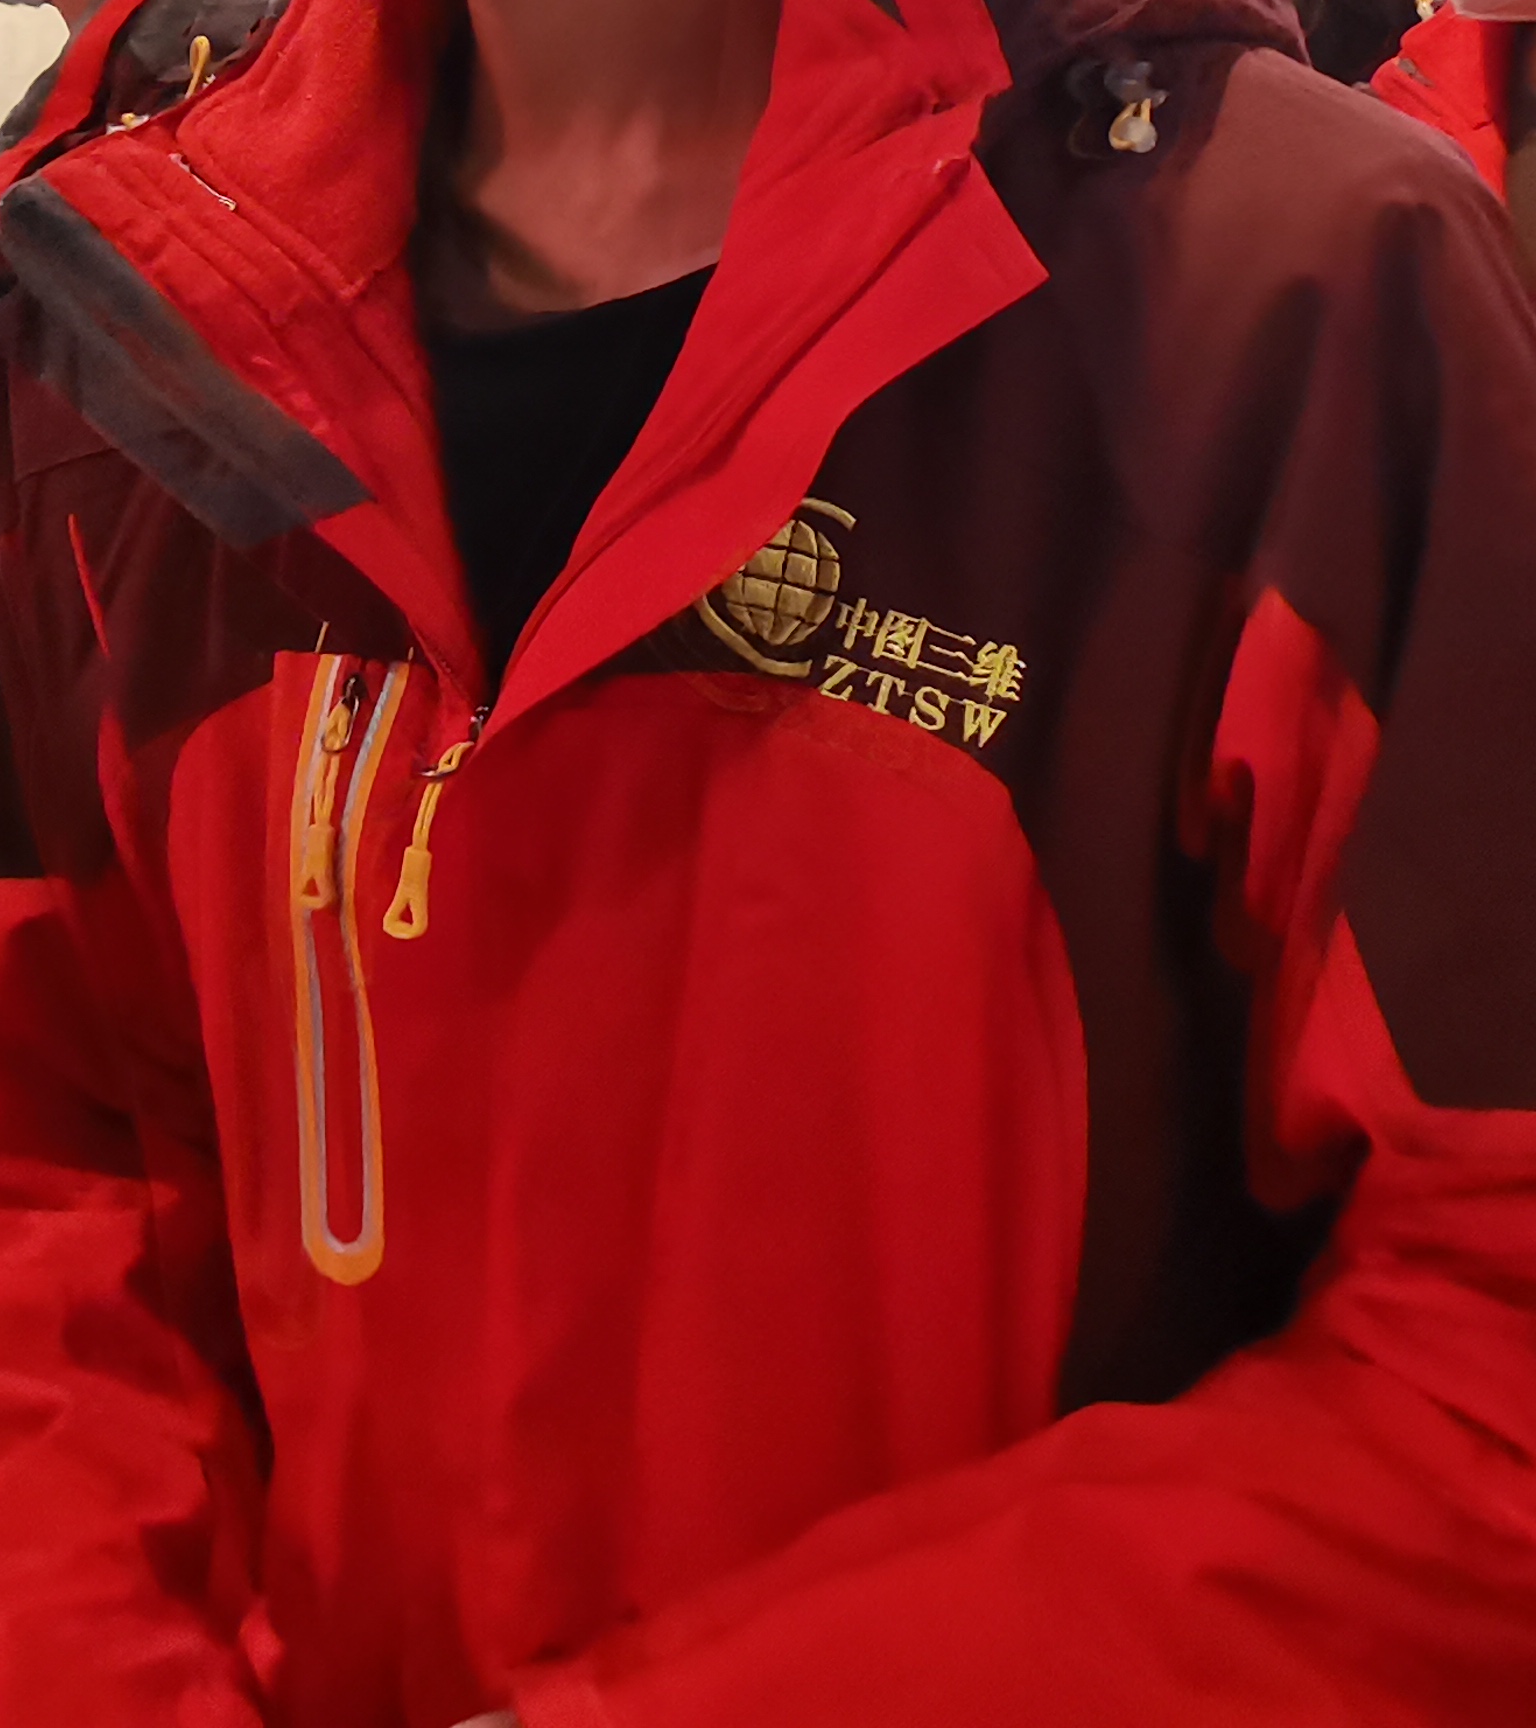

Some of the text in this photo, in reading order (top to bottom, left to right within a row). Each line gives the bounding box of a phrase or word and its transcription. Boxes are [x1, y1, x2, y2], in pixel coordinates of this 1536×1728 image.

[836, 597, 1027, 702] 中图三维
[820, 654, 1007, 748] ZTSW
